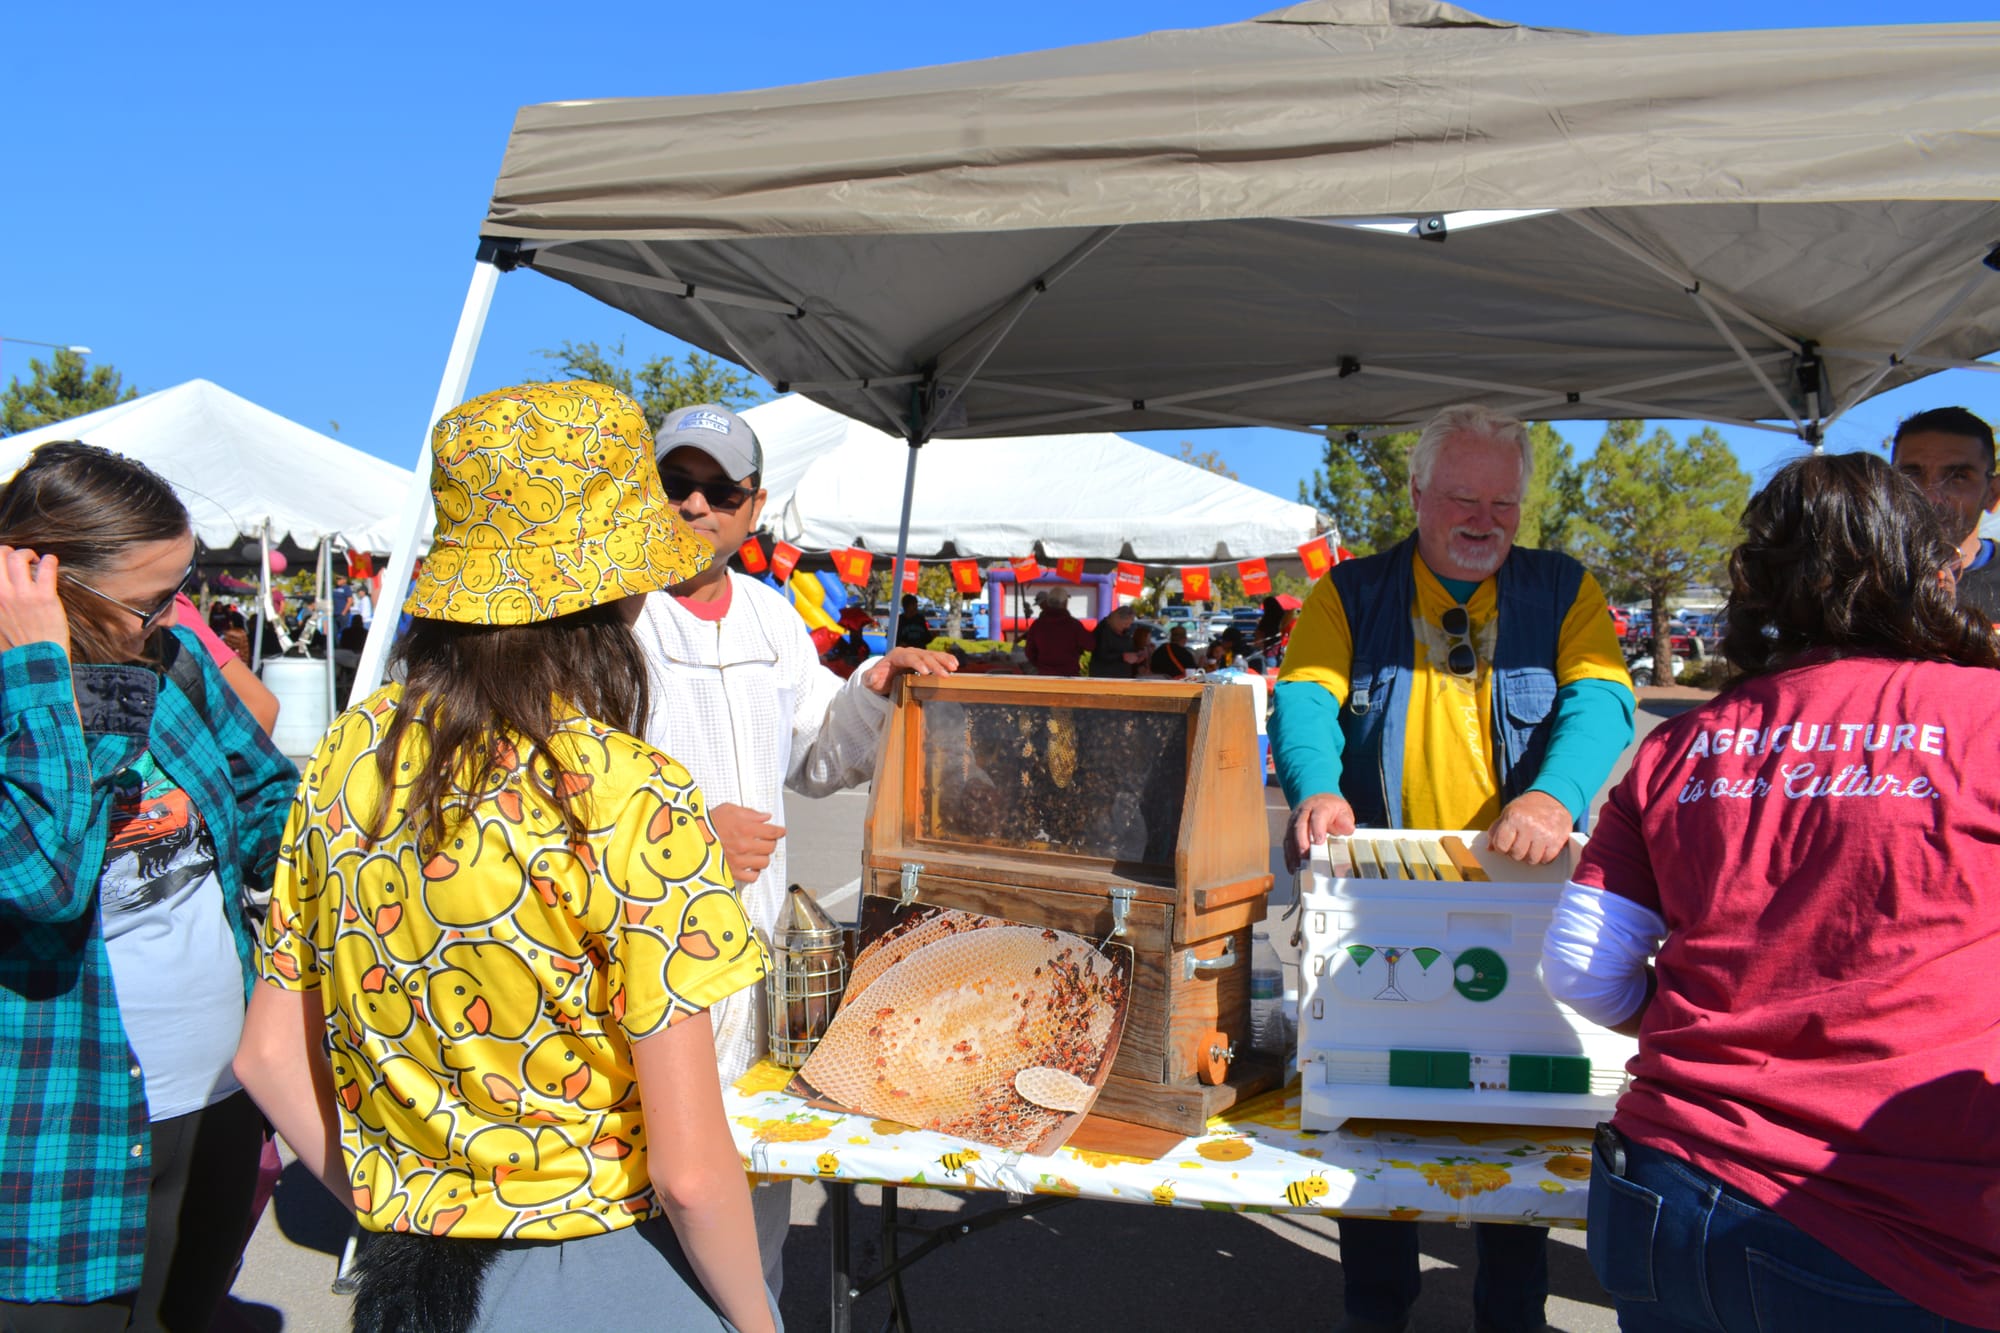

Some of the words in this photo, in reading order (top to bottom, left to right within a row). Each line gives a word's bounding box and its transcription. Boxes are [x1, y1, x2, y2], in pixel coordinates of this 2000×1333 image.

[1686, 721, 1946, 759] AGRICULTURE
[1678, 776, 1705, 804] is
[1709, 777, 1772, 799] our
[1780, 763, 1940, 800] Culture.
